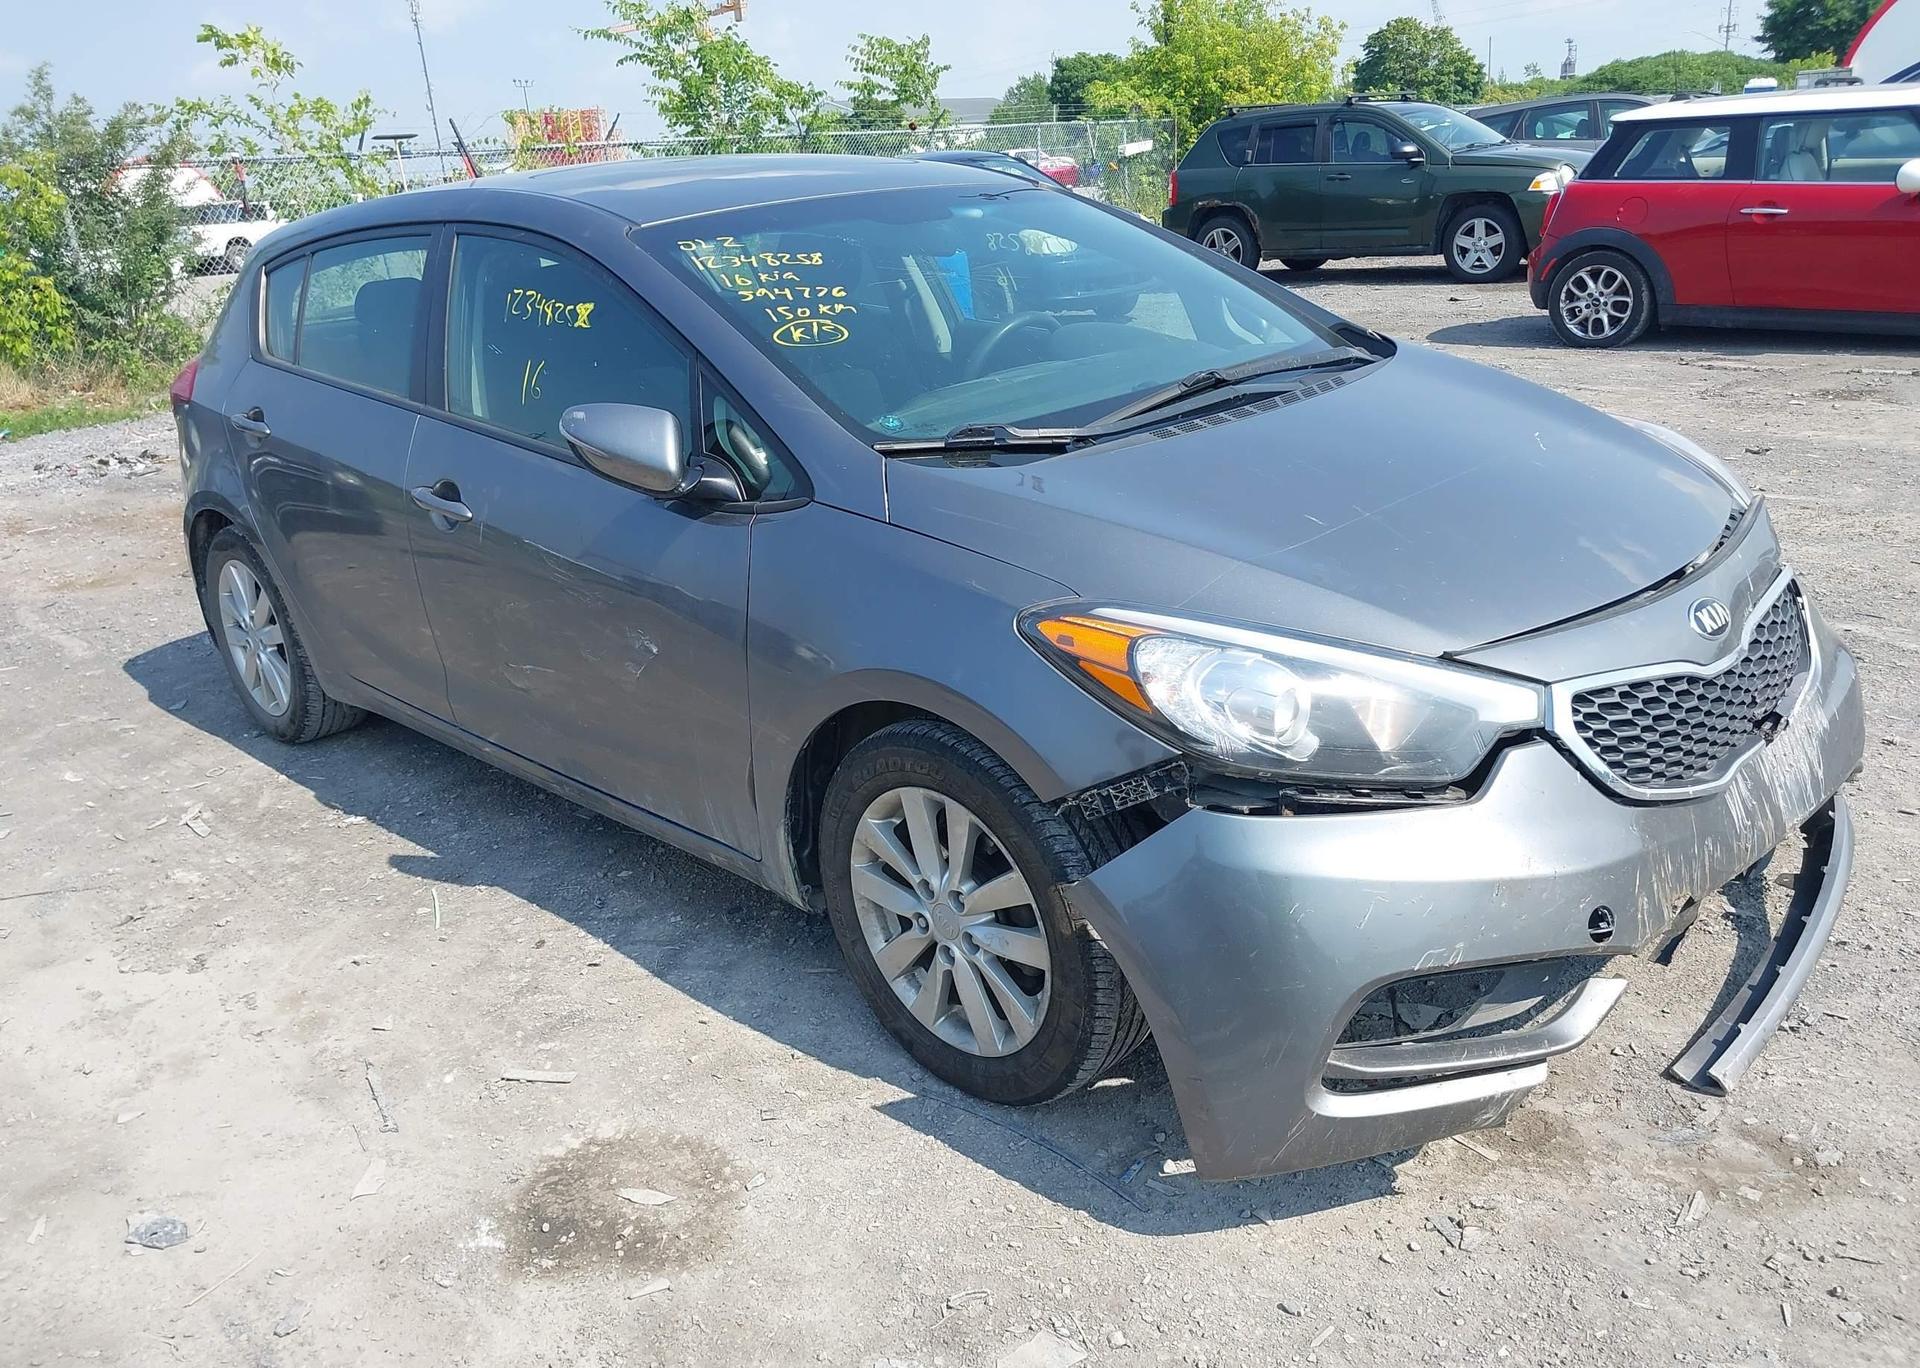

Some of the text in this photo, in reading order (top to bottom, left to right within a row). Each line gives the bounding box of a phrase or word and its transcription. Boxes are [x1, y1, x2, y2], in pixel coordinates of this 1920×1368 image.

[691, 252, 823, 270] 12348258
[522, 360, 545, 404] 16
[1694, 602, 1729, 633] KIA
